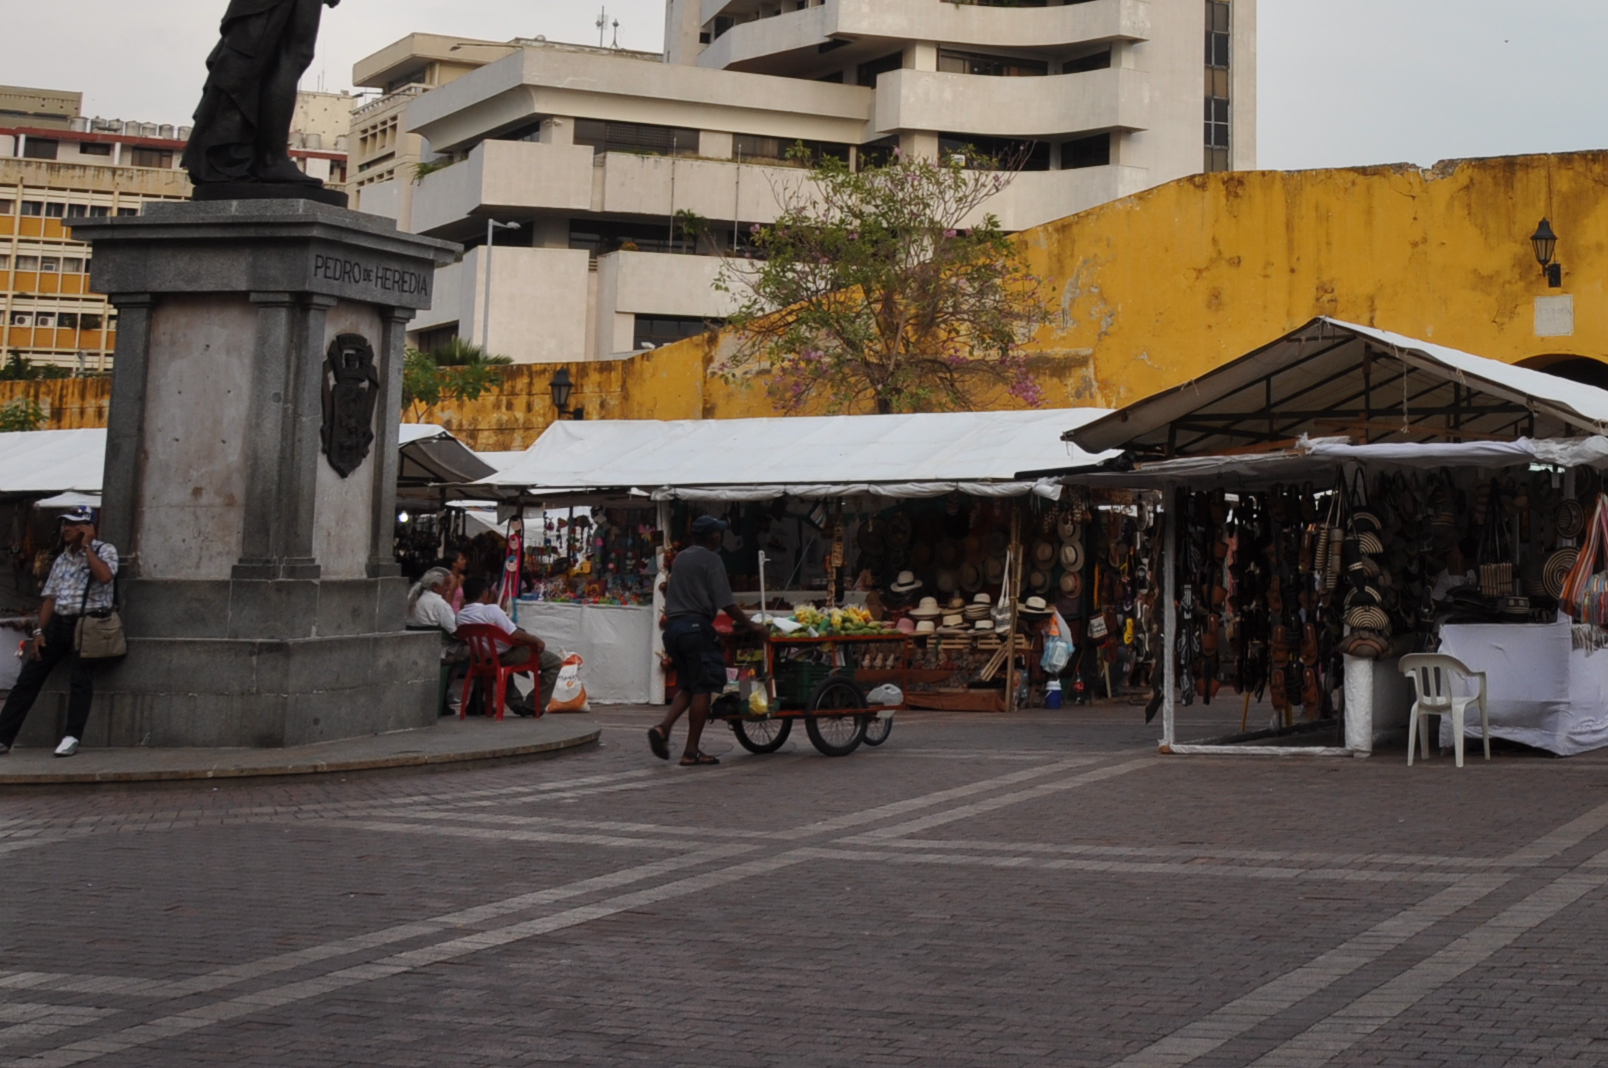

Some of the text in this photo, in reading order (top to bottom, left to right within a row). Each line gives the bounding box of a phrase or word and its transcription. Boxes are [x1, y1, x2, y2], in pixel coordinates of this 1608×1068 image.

[314, 254, 428, 296] PEDRO DE HEREDIA
